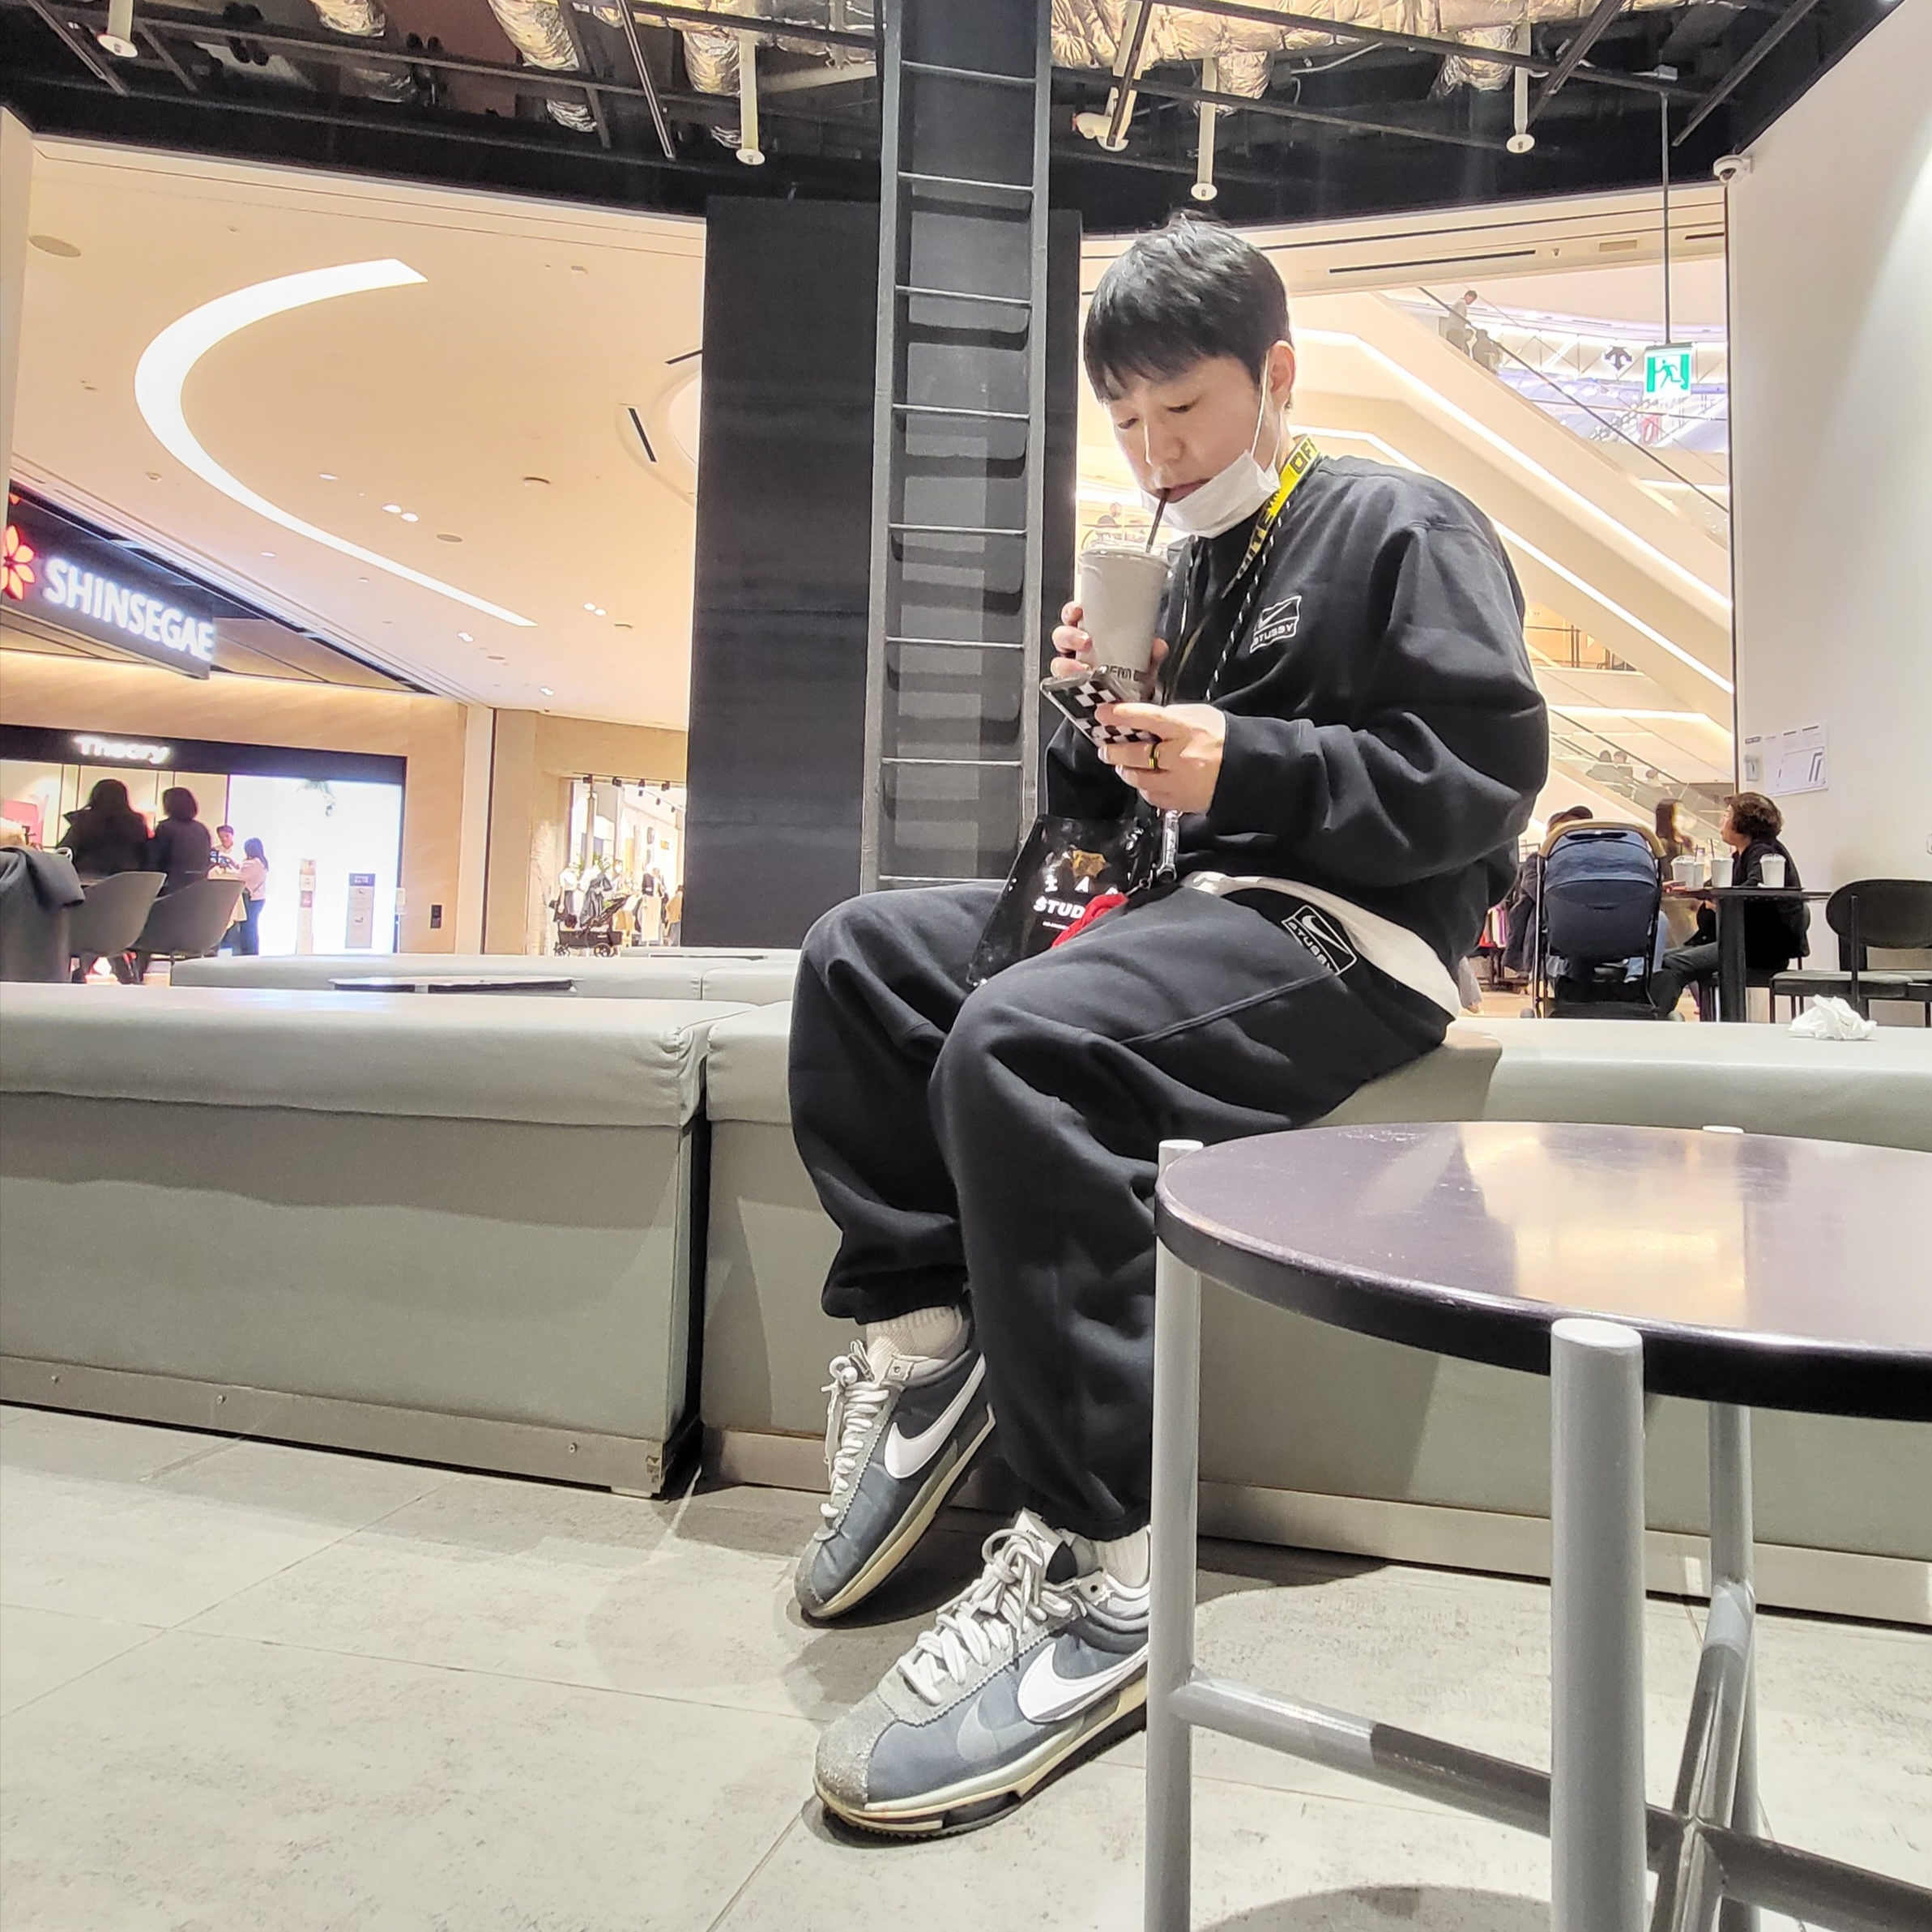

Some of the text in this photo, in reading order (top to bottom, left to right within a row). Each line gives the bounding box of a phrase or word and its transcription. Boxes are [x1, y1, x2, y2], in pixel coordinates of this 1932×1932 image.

[43, 557, 215, 662] SHINSEGAE
[1253, 623, 1294, 645] STUSSY
[74, 736, 169, 764] Theory
